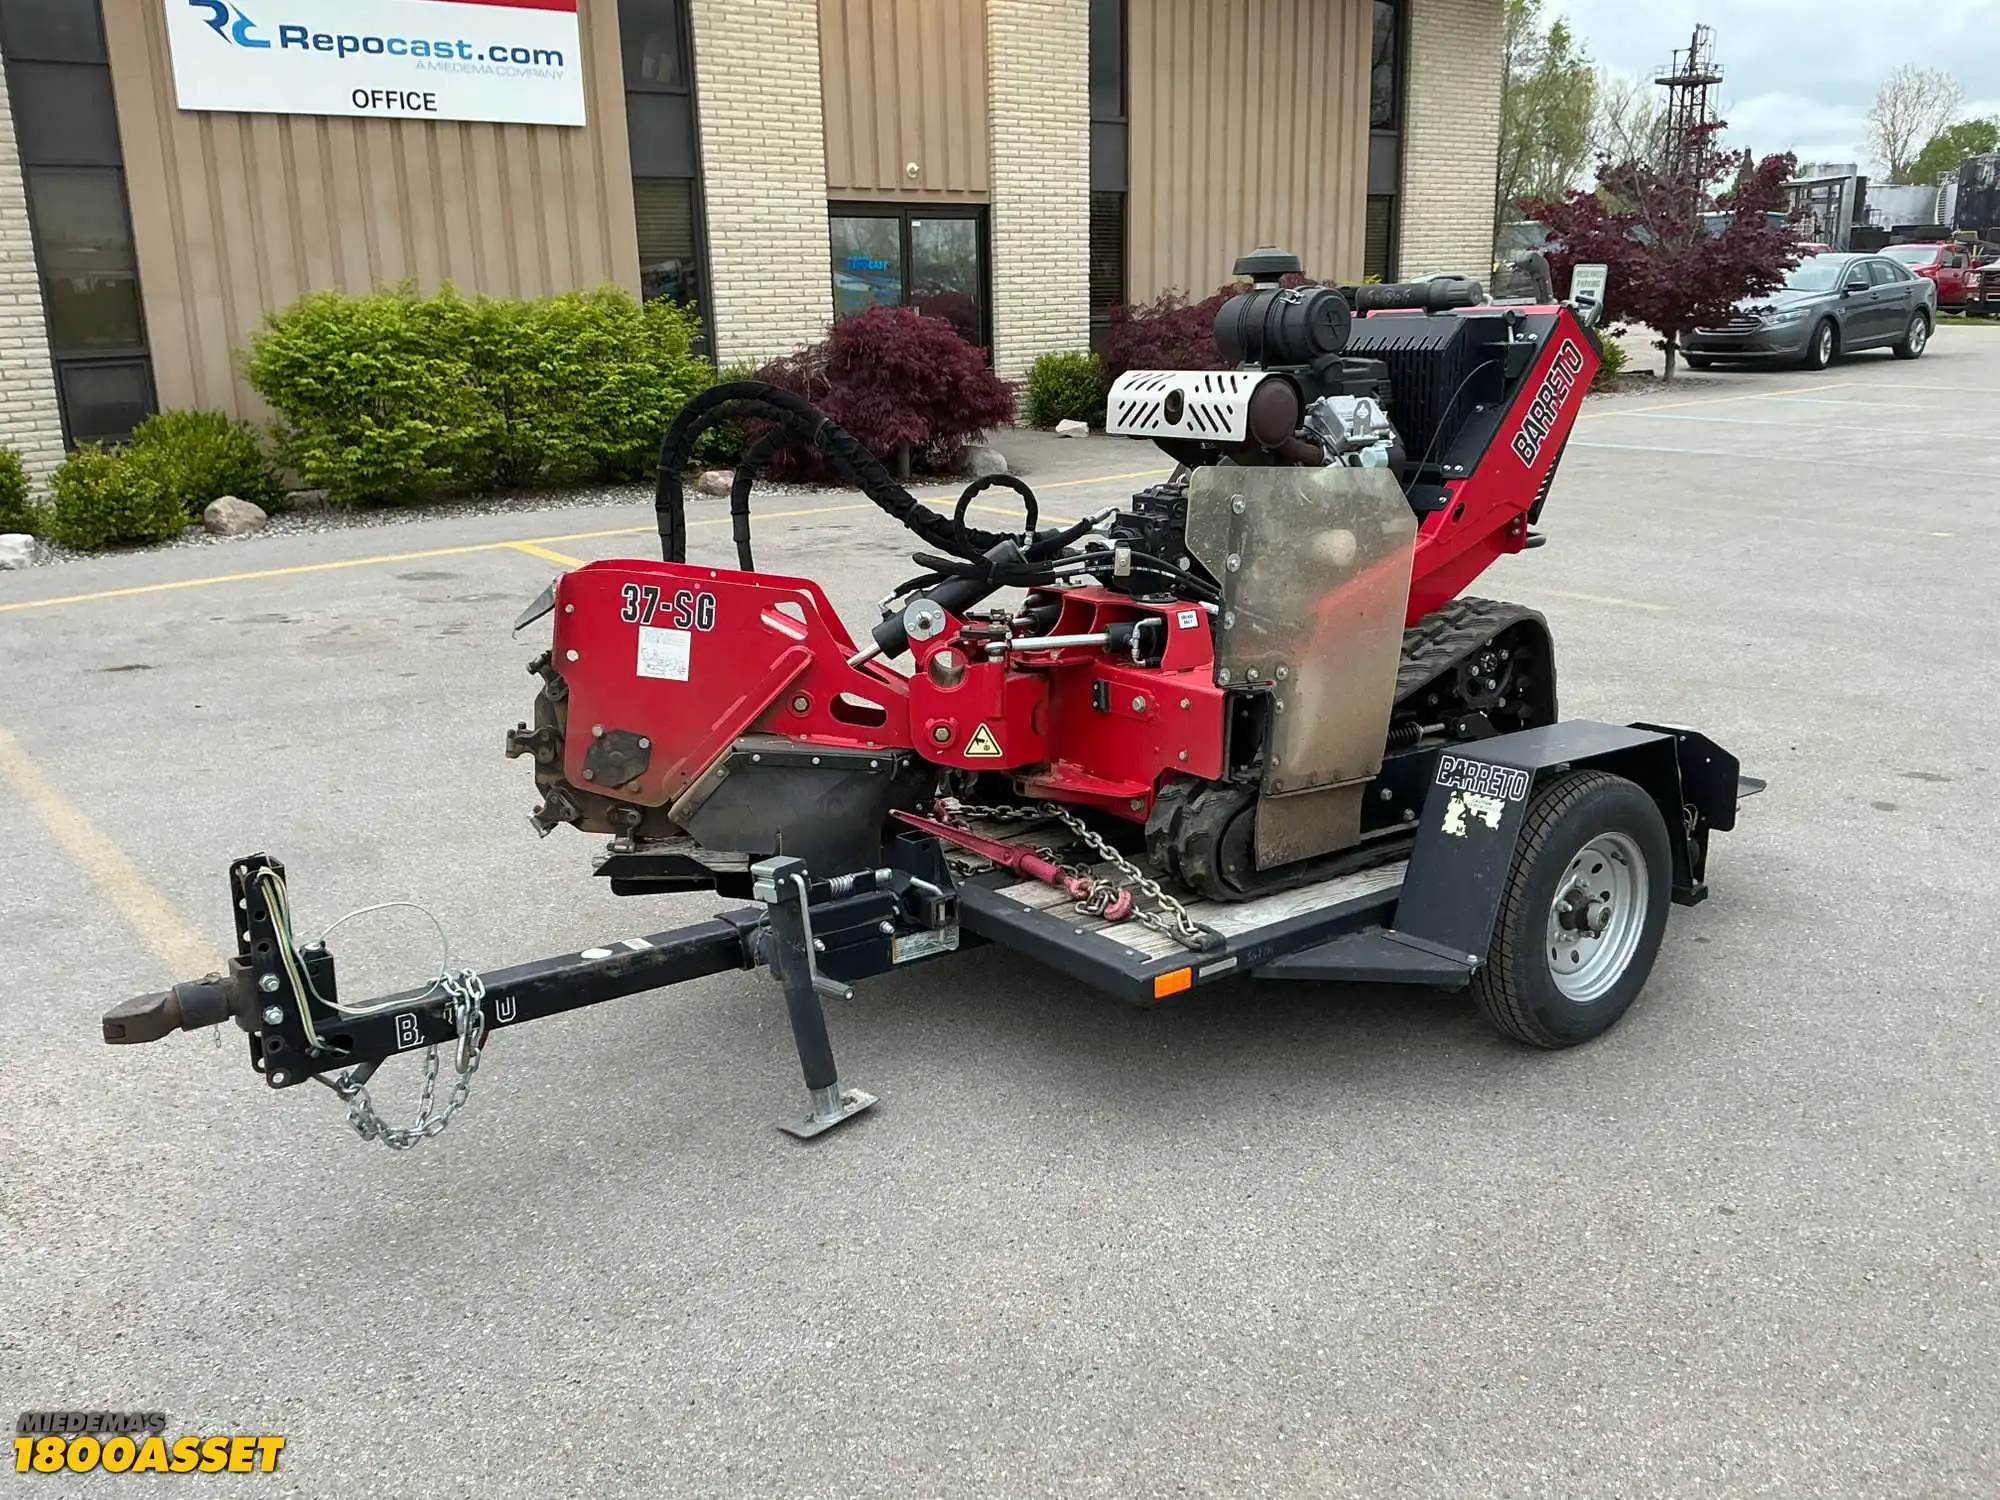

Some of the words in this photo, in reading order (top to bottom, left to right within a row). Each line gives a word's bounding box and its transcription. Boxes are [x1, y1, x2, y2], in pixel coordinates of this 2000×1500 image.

[279, 24, 564, 67] Repocast.com
[415, 59, 426, 70] A
[427, 60, 494, 75] MIEDEMA
[352, 88, 437, 111] OFFICE
[1511, 338, 1583, 468] BARRETO
[621, 583, 716, 631] 37-SG
[1436, 755, 1529, 801] BARRETO
